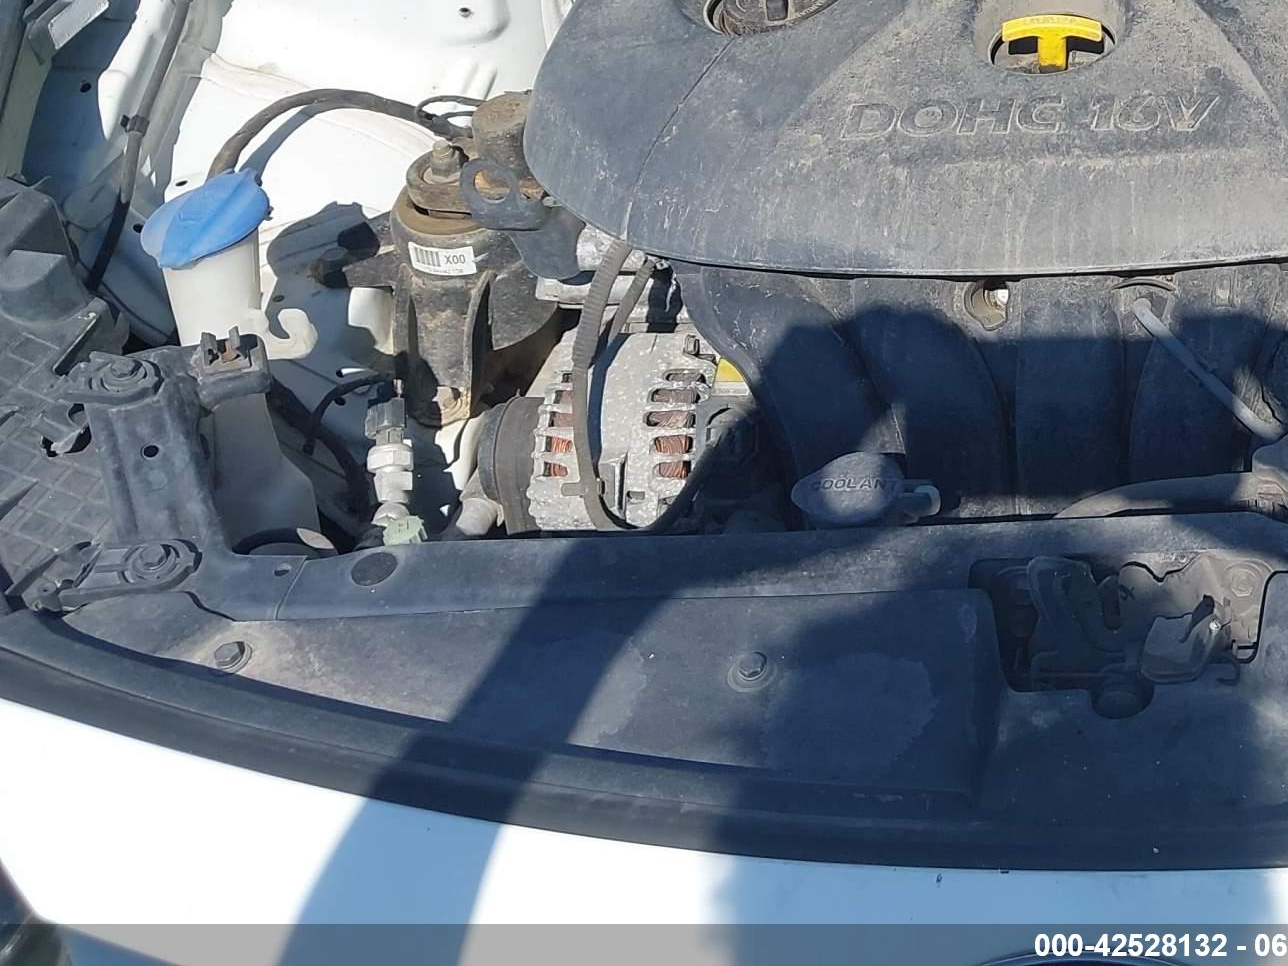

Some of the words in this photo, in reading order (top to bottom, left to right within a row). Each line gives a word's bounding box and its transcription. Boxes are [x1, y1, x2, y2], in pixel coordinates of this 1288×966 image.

[841, 96, 1066, 137] DOHC
[1089, 94, 1220, 132] 16V
[444, 254, 466, 265] X00
